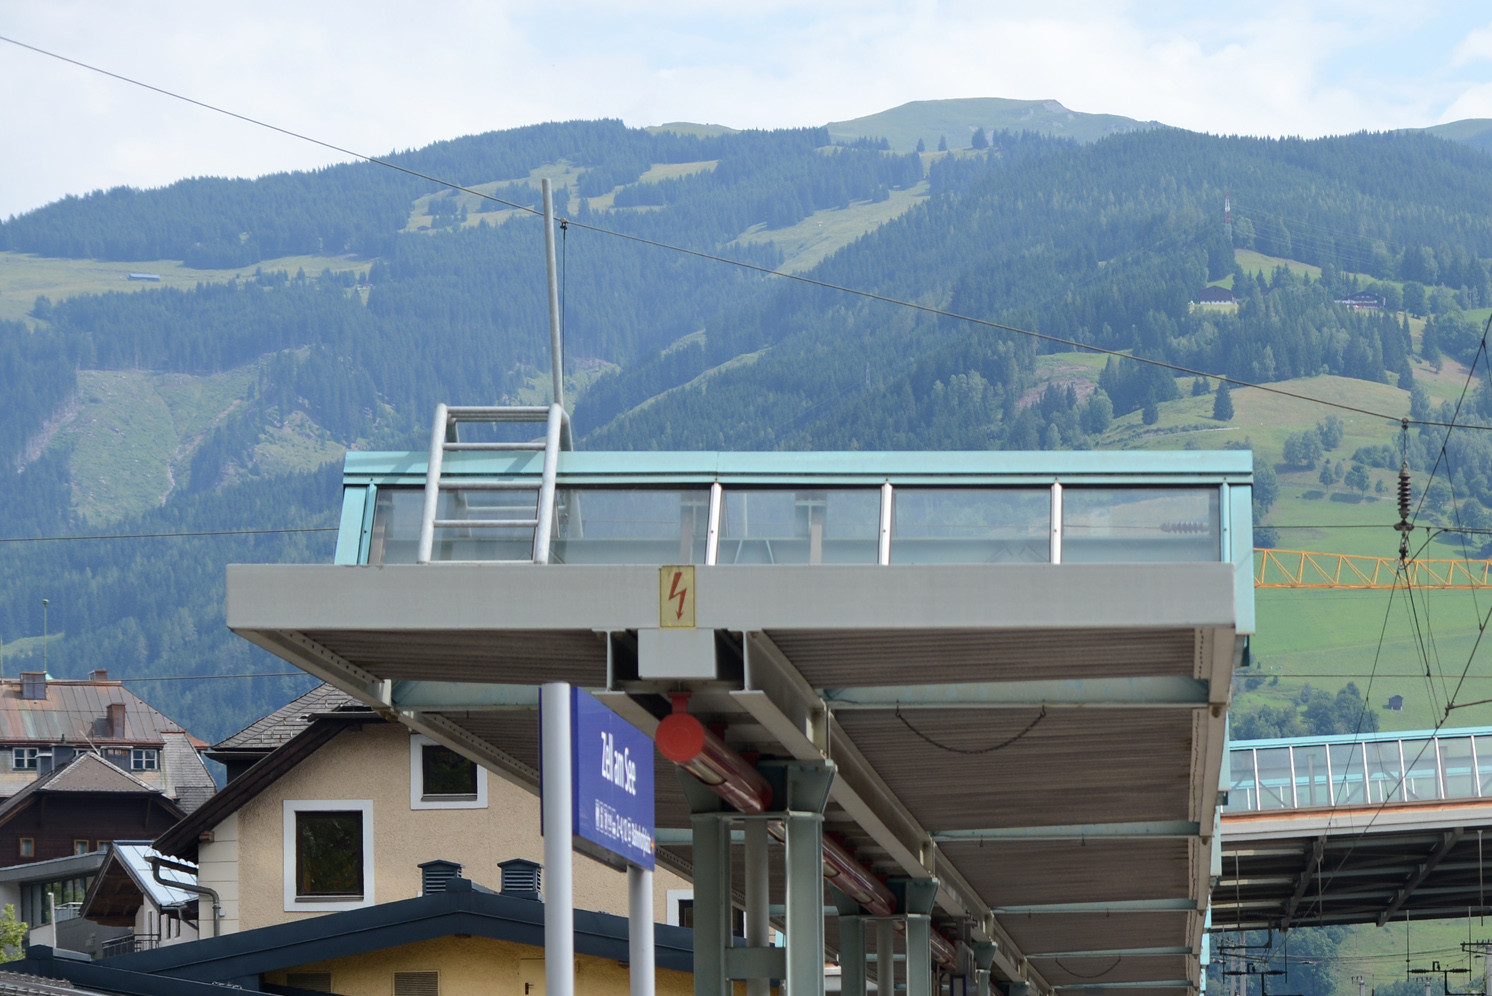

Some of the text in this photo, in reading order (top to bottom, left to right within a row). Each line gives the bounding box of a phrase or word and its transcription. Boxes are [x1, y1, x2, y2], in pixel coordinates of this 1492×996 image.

[601, 731, 636, 796] Zell am See
